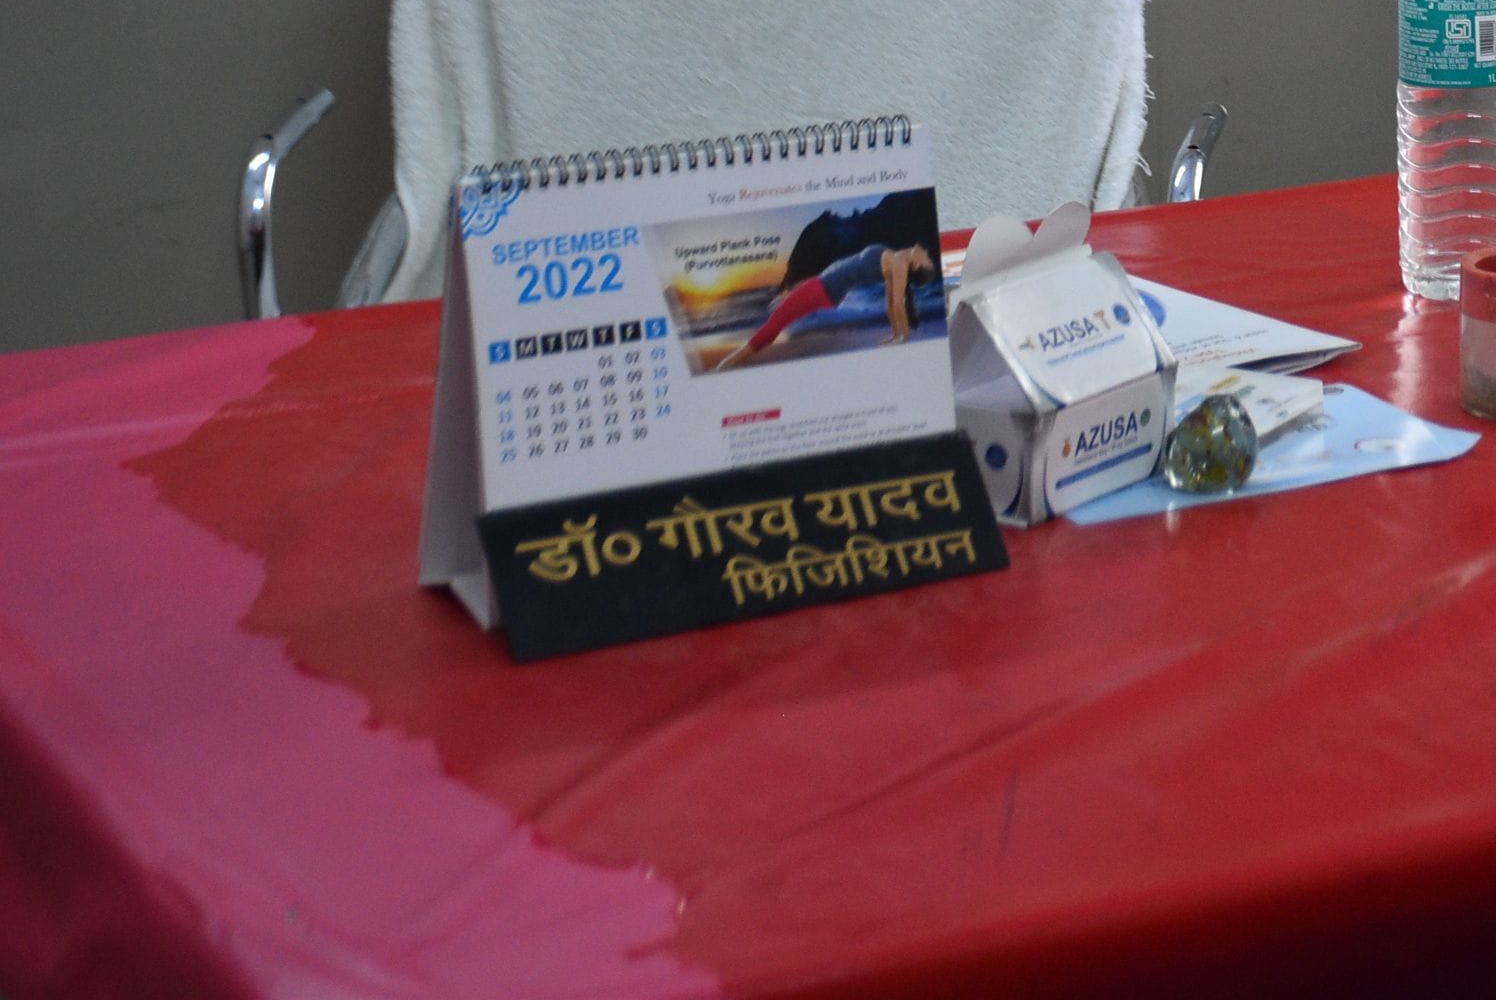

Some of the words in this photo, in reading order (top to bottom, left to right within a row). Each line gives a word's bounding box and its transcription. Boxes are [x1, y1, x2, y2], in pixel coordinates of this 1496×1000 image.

[825, 174, 854, 190] Mind
[856, 172, 876, 186] and
[491, 226, 640, 265] SEPTEMBER
[720, 237, 751, 250] Plank
[753, 235, 781, 247] Pose
[516, 253, 624, 304] 2022
[1037, 317, 1099, 352] AZUSA
[598, 355, 612, 369] 01
[625, 351, 640, 364] 02
[651, 348, 666, 360] 03
[496, 390, 512, 405] 04
[523, 386, 539, 400] 05
[549, 382, 564, 395] 06
[573, 378, 589, 392] 07
[600, 374, 616, 387] 08
[627, 370, 642, 383] 09
[654, 367, 668, 379] 10
[498, 410, 512, 424] 11
[526, 405, 540, 419] 12
[551, 402, 566, 415] 13
[576, 398, 590, 412] 14
[603, 393, 617, 406] 15
[630, 389, 644, 402] 16
[655, 385, 669, 398] 17
[501, 429, 514, 443] 18
[528, 425, 542, 439] 19
[552, 421, 568, 434] 20
[577, 417, 591, 430] 21
[605, 412, 619, 425] 22
[631, 408, 646, 421] 23
[656, 404, 671, 418] 24
[1074, 410, 1138, 457] AZUSA
[502, 449, 517, 462] 25
[529, 444, 544, 458] 26
[554, 440, 569, 453] 27
[579, 436, 594, 449] 28
[606, 432, 621, 445] 29
[633, 427, 648, 440] 30
[646, 496, 800, 559] गौरव
[803, 470, 962, 531] यादव
[722, 529, 978, 606] फिजिशियन
